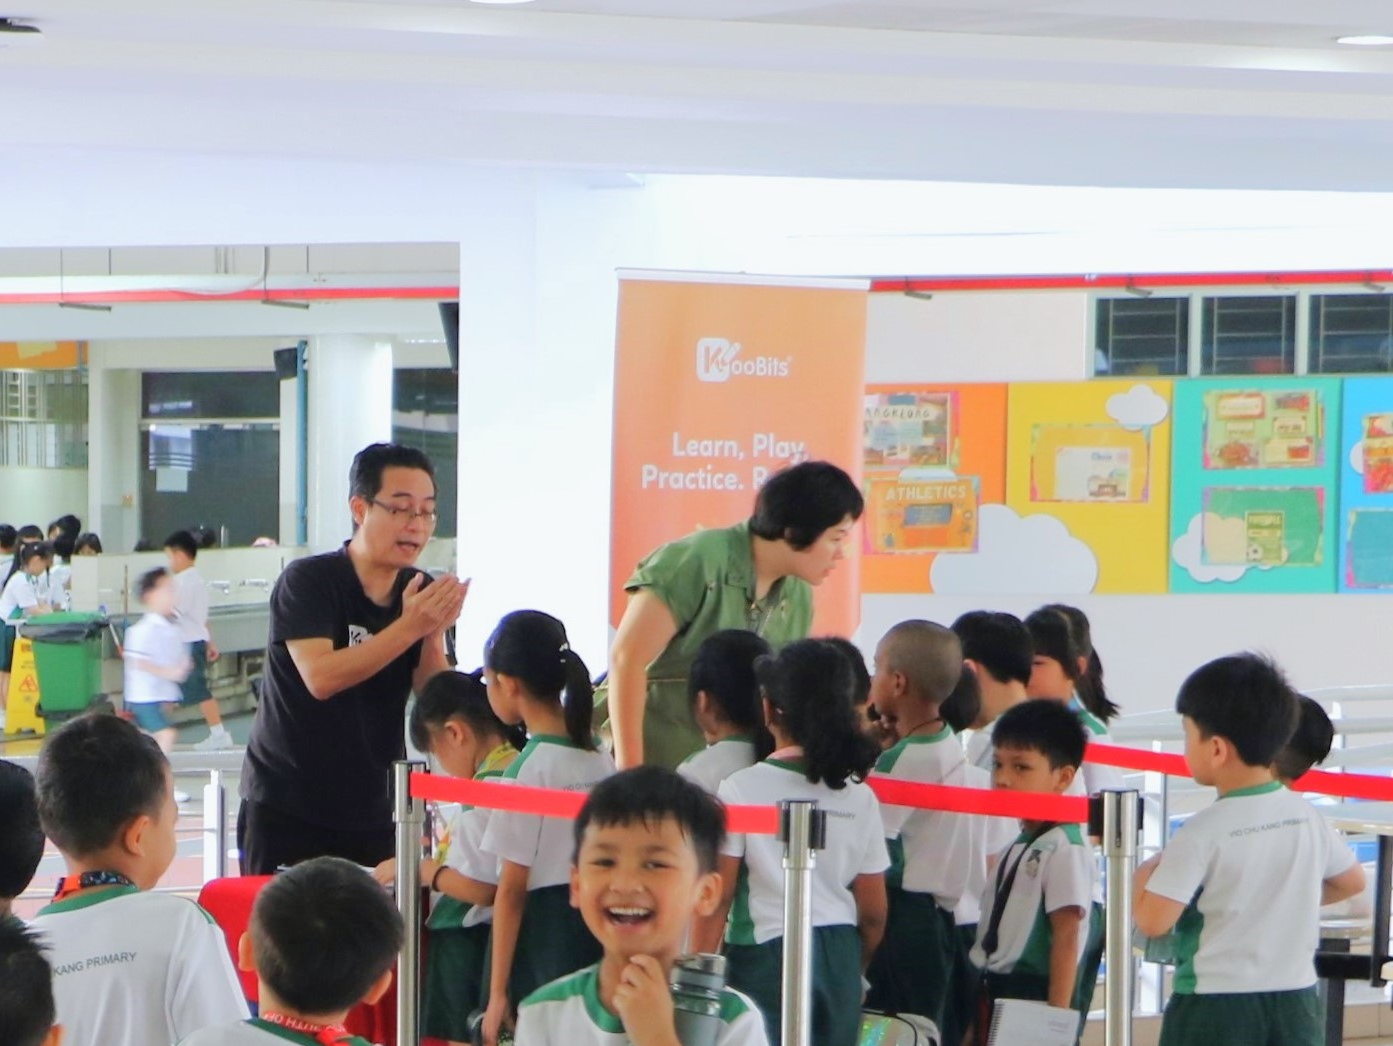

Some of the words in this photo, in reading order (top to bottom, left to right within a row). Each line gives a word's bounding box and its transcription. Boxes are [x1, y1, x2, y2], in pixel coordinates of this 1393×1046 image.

[672, 431, 745, 460] Learn,
[641, 464, 745, 490] Practice.
[885, 486, 967, 501] ATHLETICS
[86, 951, 138, 969] PRIMARY
